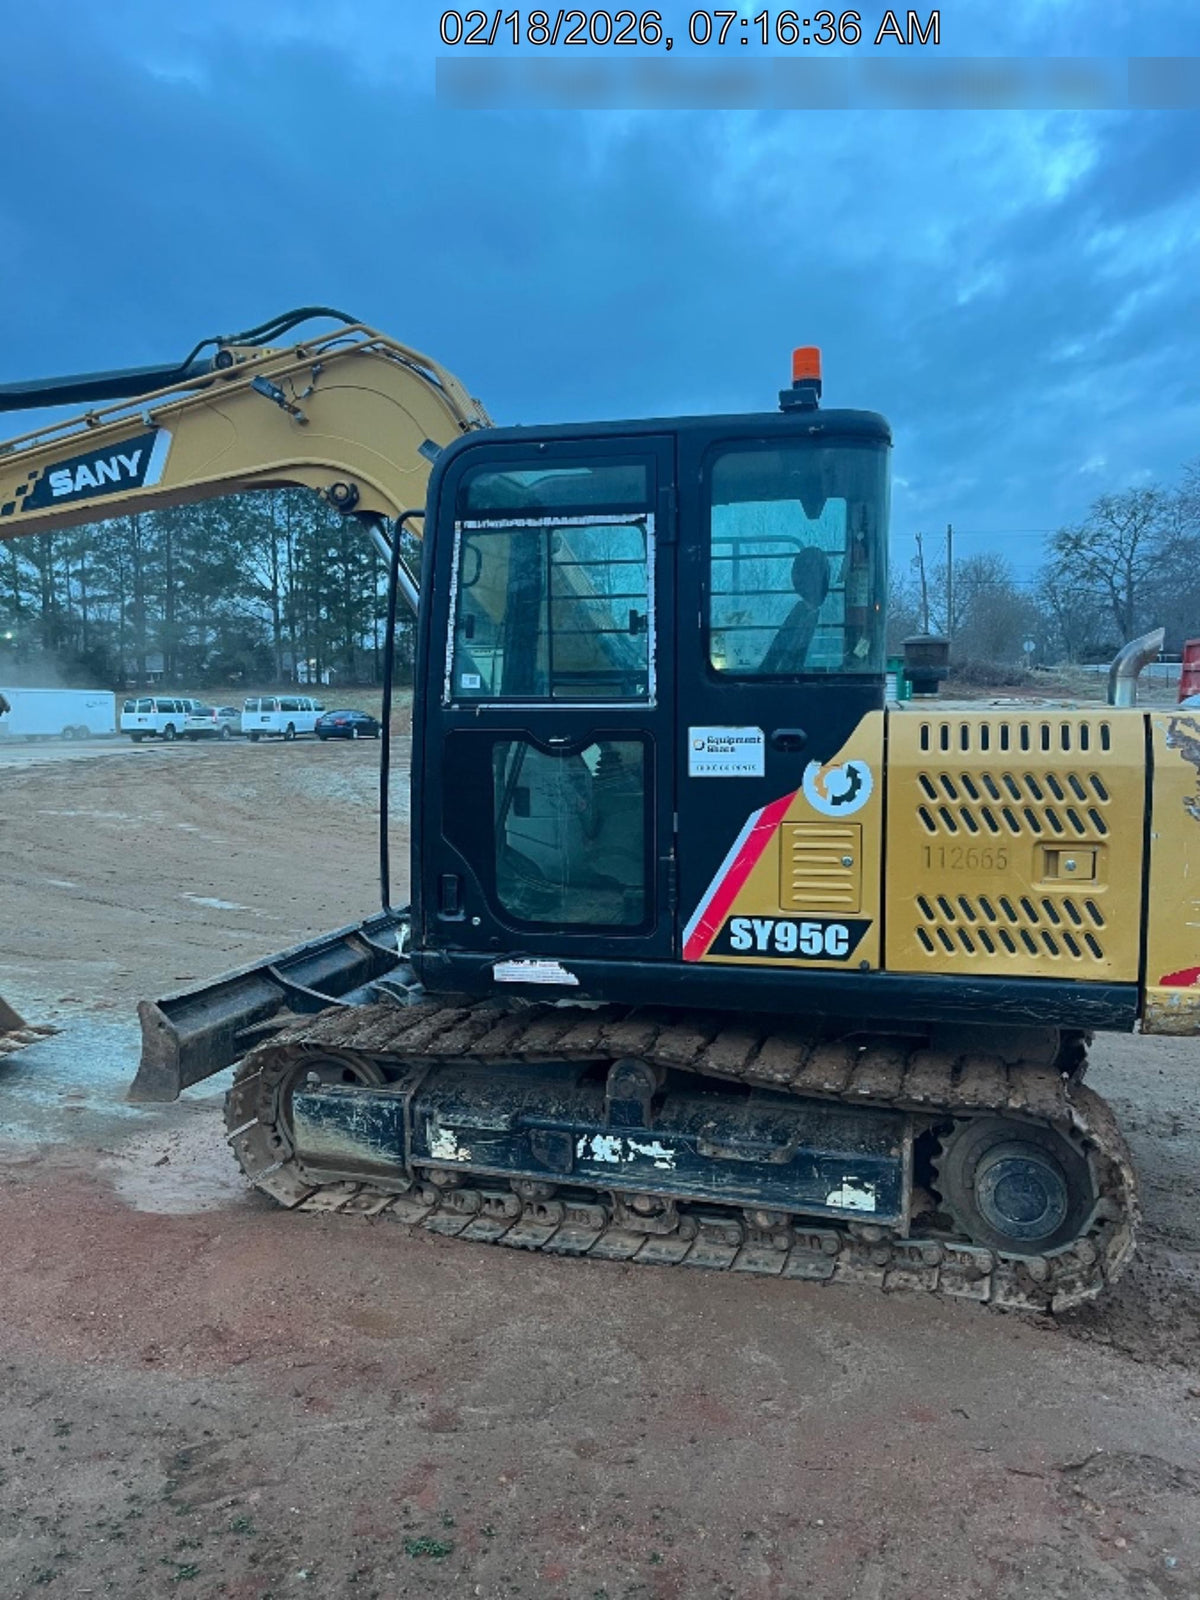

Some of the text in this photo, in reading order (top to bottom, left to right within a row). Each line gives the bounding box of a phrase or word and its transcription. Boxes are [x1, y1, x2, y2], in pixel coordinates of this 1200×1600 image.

[49, 449, 143, 497] SANY
[924, 845, 1008, 870] 112665
[730, 919, 849, 956] SY95C
